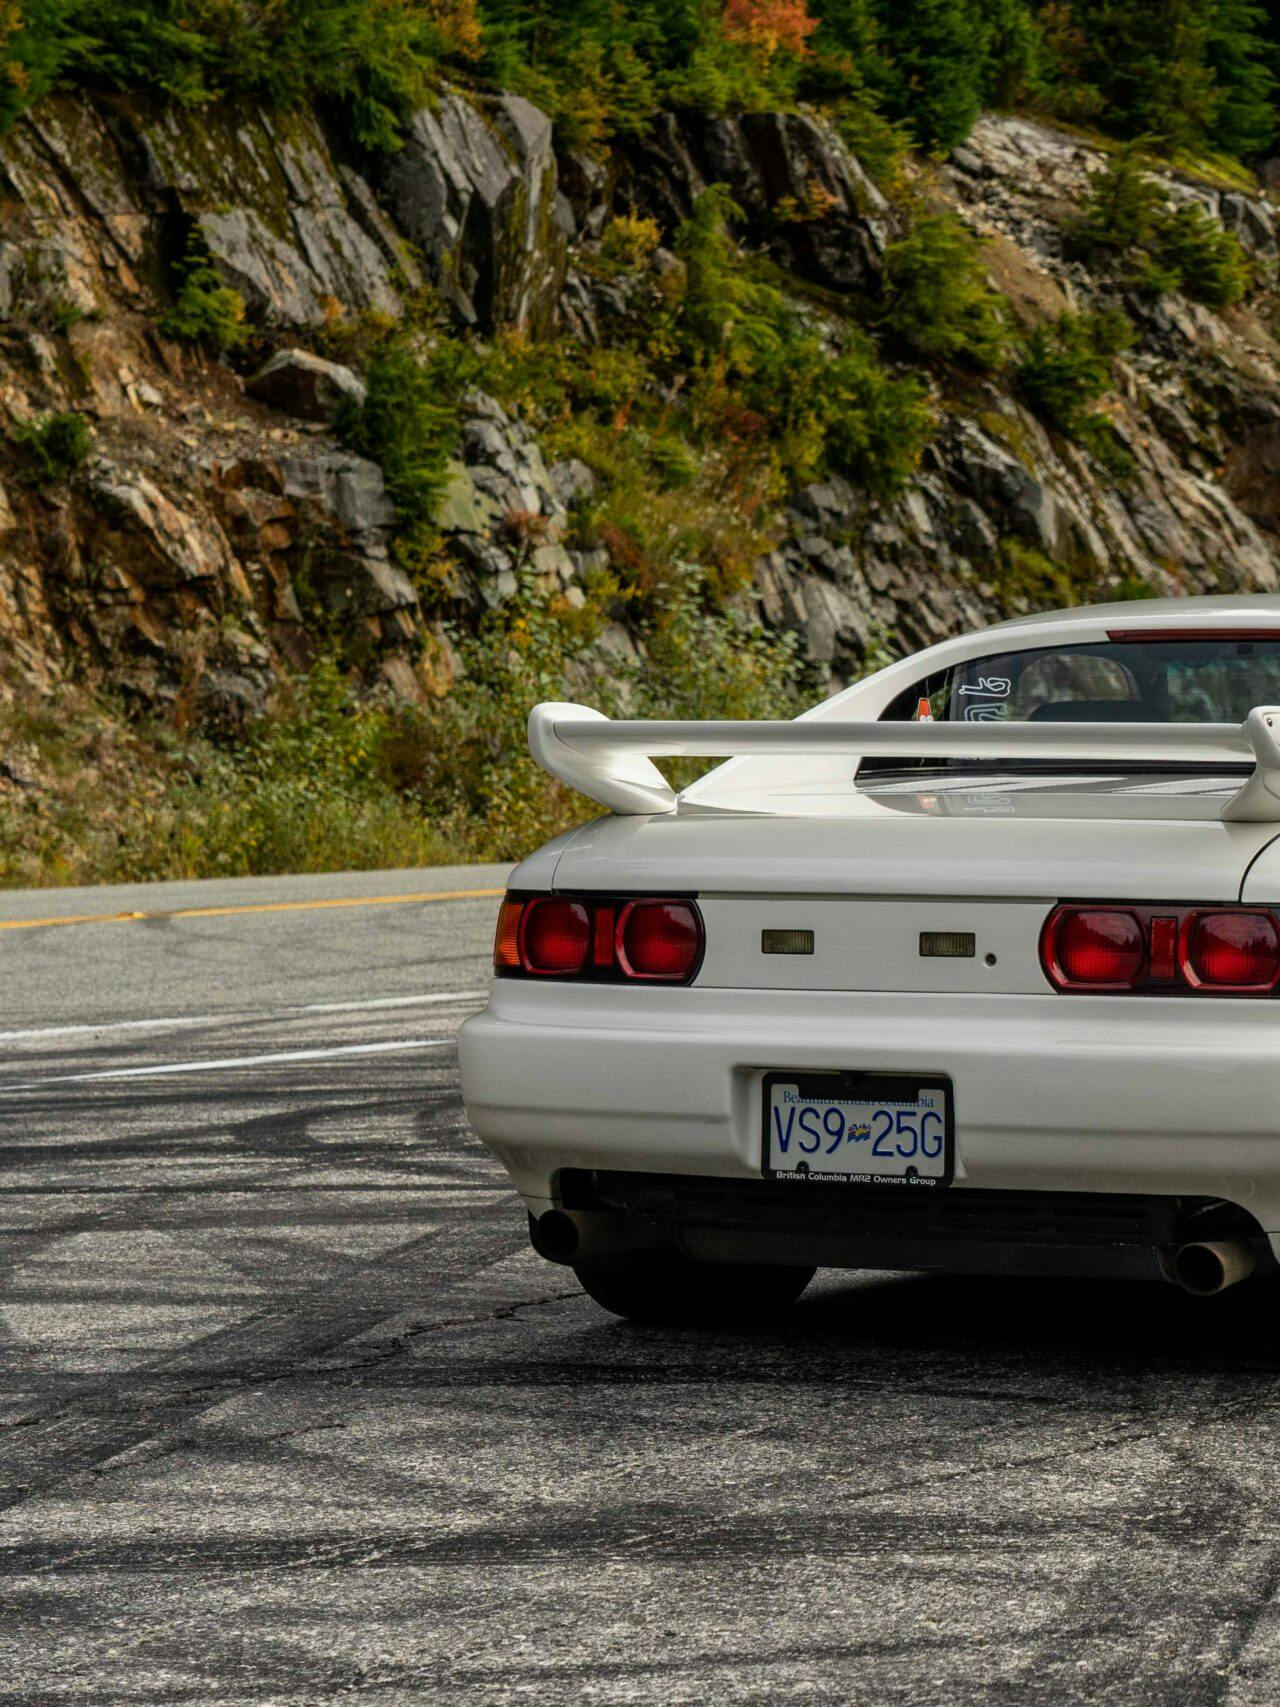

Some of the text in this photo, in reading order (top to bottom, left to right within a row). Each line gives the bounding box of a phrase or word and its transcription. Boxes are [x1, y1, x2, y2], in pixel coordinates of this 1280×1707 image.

[774, 1105, 944, 1158] VS9 25G
[776, 1170, 937, 1187] British Columbia MR2 Owners Group
